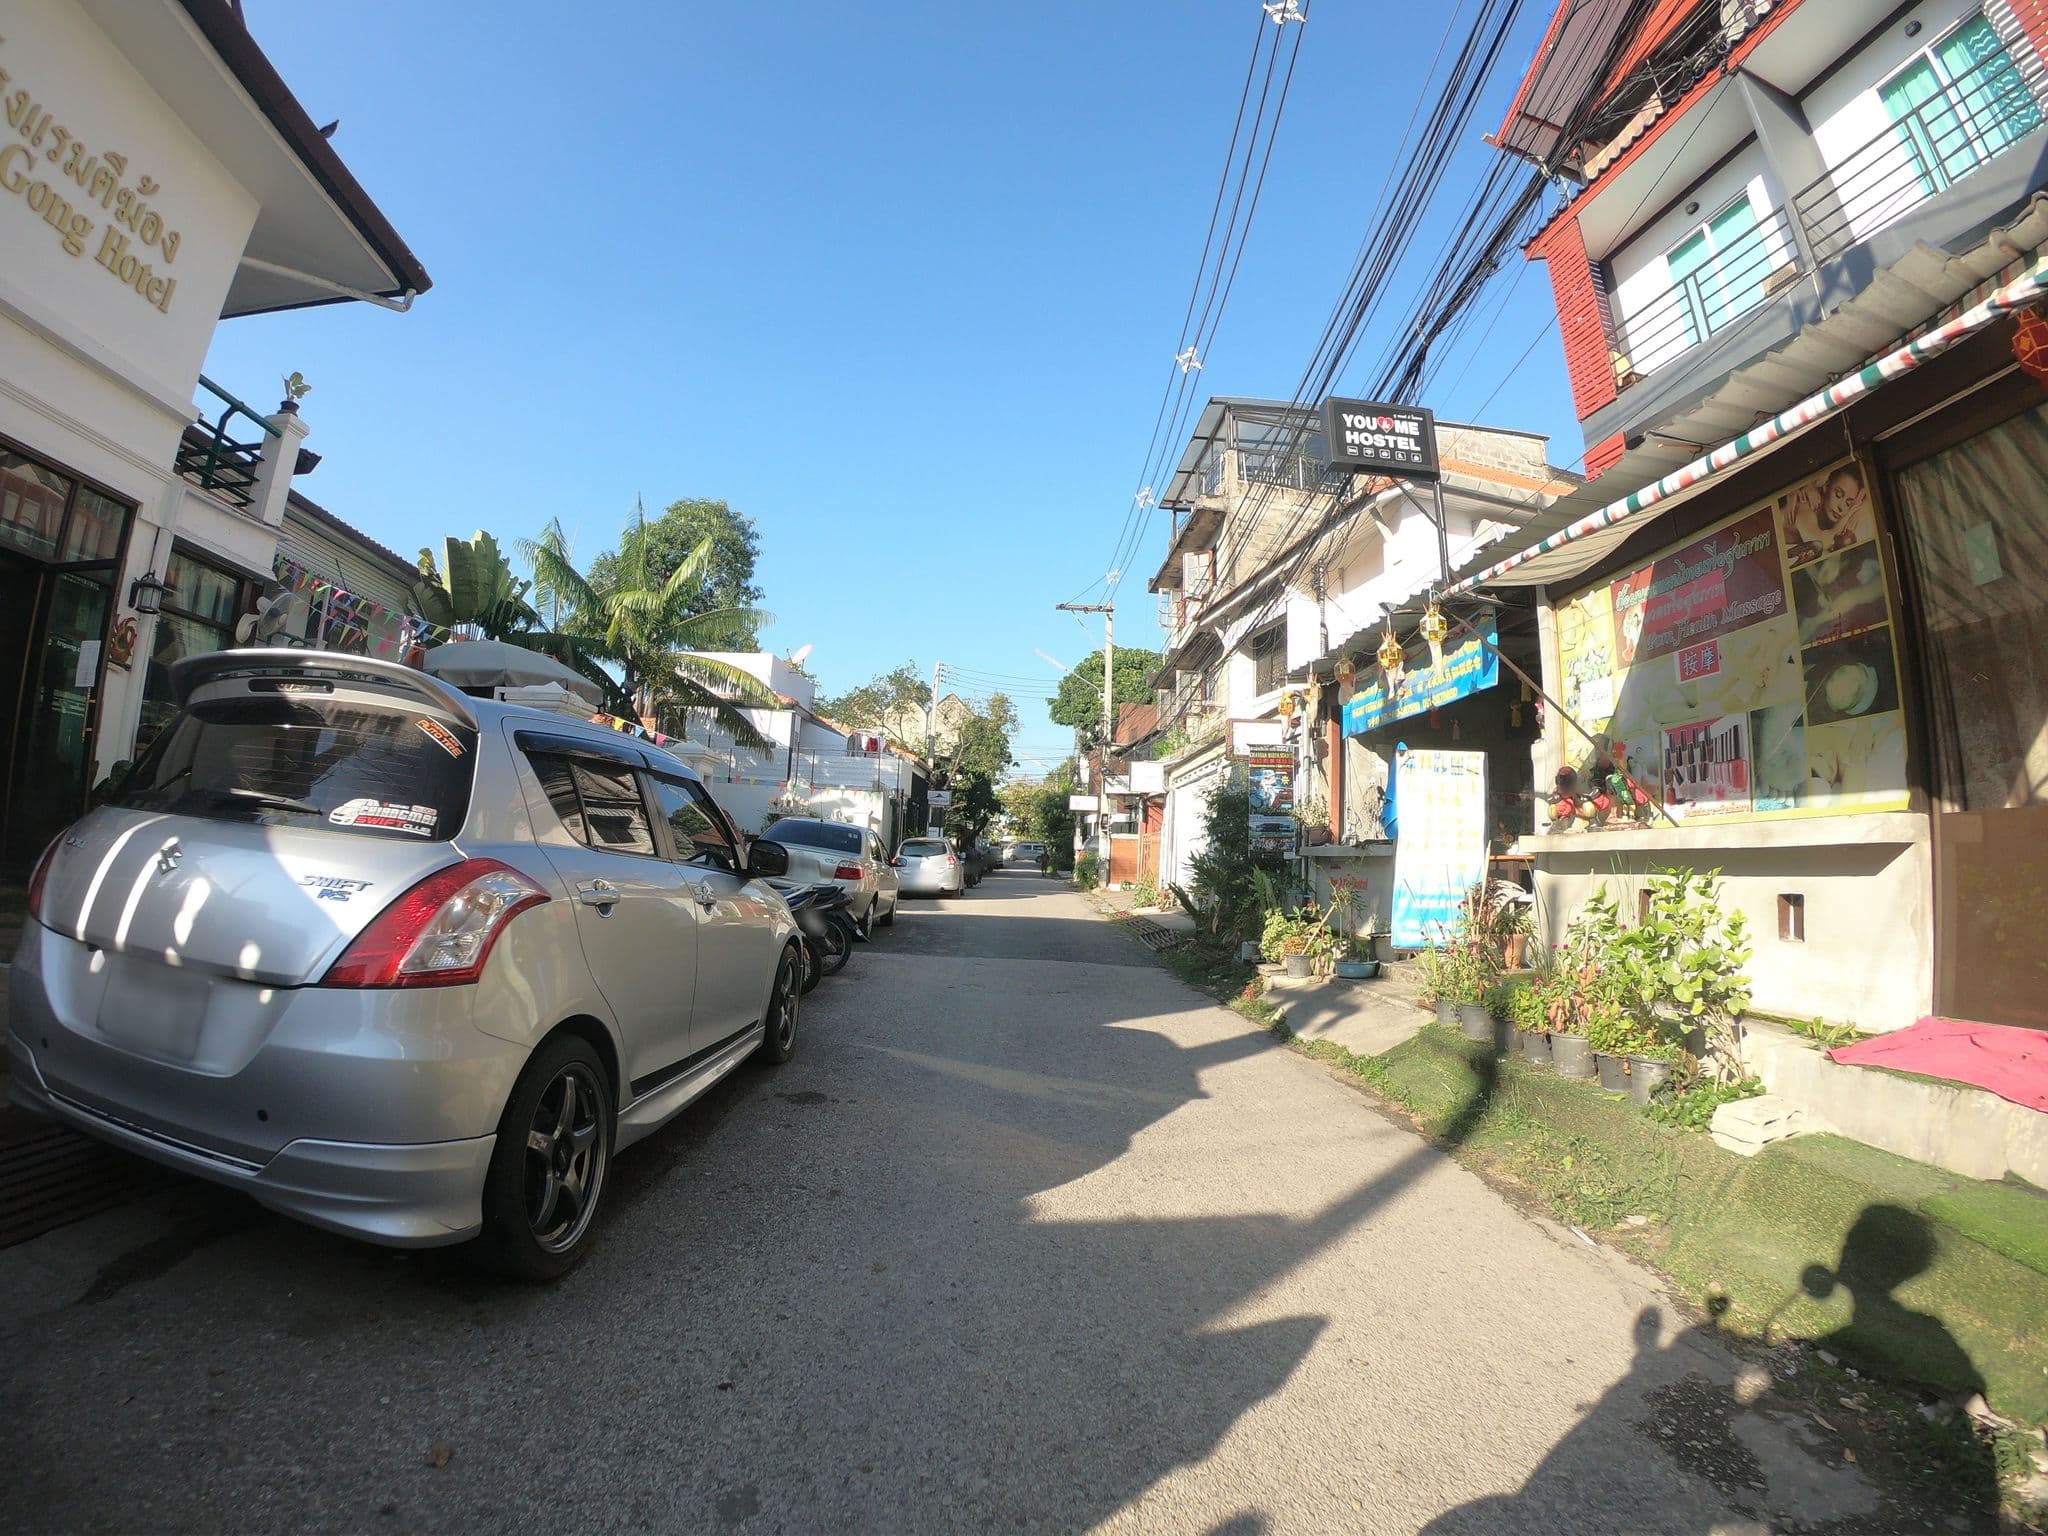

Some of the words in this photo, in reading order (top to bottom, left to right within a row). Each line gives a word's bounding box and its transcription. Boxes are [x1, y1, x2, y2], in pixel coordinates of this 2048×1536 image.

[0, 36, 181, 264] งแรมตีฆ้อง
[0, 144, 95, 257] Gong
[94, 224, 177, 313] Hotel
[1342, 413, 1378, 430] YOU
[1394, 419, 1419, 435] ME
[1345, 431, 1421, 451] HOSTEL
[1720, 588, 1782, 625] Massage
[1683, 646, 1716, 676] 按摩
[417, 719, 443, 739] AUTO
[355, 815, 407, 828] SWIFT
[298, 876, 374, 891] SWIFT
[317, 889, 352, 902] RS
